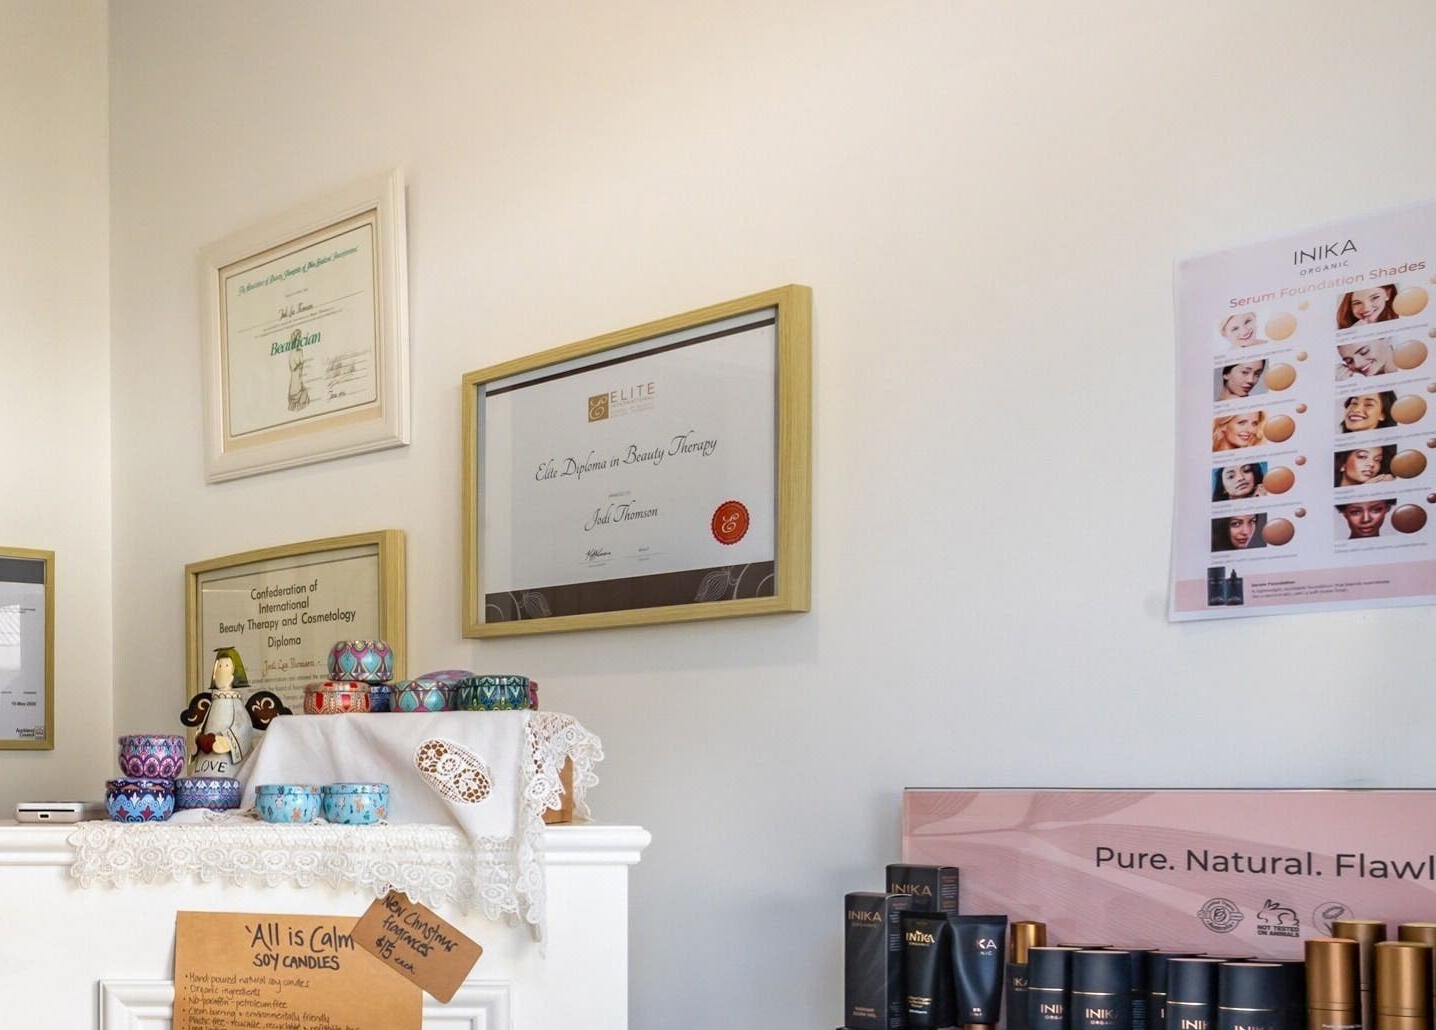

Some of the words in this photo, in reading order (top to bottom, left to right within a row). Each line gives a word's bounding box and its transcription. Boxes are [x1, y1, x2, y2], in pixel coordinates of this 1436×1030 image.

[1293, 239, 1358, 265] INIKA
[1299, 260, 1349, 276] ORGANIC
[1229, 292, 1275, 309] Serum
[1279, 274, 1364, 298] Foundation
[1369, 261, 1427, 280] Shades
[270, 331, 321, 356] Beautician
[611, 382, 655, 403] ELITE
[535, 459, 558, 481] Elite
[560, 451, 607, 480] Diploma
[610, 454, 620, 468] in
[622, 445, 665, 466] Beauty
[668, 430, 717, 456] Therapy
[584, 503, 615, 532] Jodi
[613, 500, 658, 523] Thomson
[250, 584, 306, 601] Confederation
[310, 579, 318, 592] of
[259, 599, 309, 614] International
[219, 621, 245, 635] Beauty
[247, 618, 279, 631] Therapy
[282, 614, 298, 626] and
[301, 608, 356, 624] Cosmetology
[268, 636, 302, 649] Diploma
[195, 760, 227, 773] LOVE
[1095, 846, 1175, 870] Pure.
[1186, 849, 1322, 876] Natural.
[891, 883, 933, 897] INIKA
[383, 895, 405, 917] New
[404, 912, 458, 952] Christmas
[848, 910, 883, 922] INIKA
[288, 927, 304, 946] is
[310, 925, 354, 953] Calm
[383, 914, 433, 957] fragrances
[905, 931, 935, 943] INIKA
[252, 953, 279, 971] SOY
[282, 955, 340, 971] CANDLES
[376, 936, 396, 959] $15
[395, 958, 415, 974] each
[190, 985, 219, 997] Organic
[239, 976, 265, 984] natural
